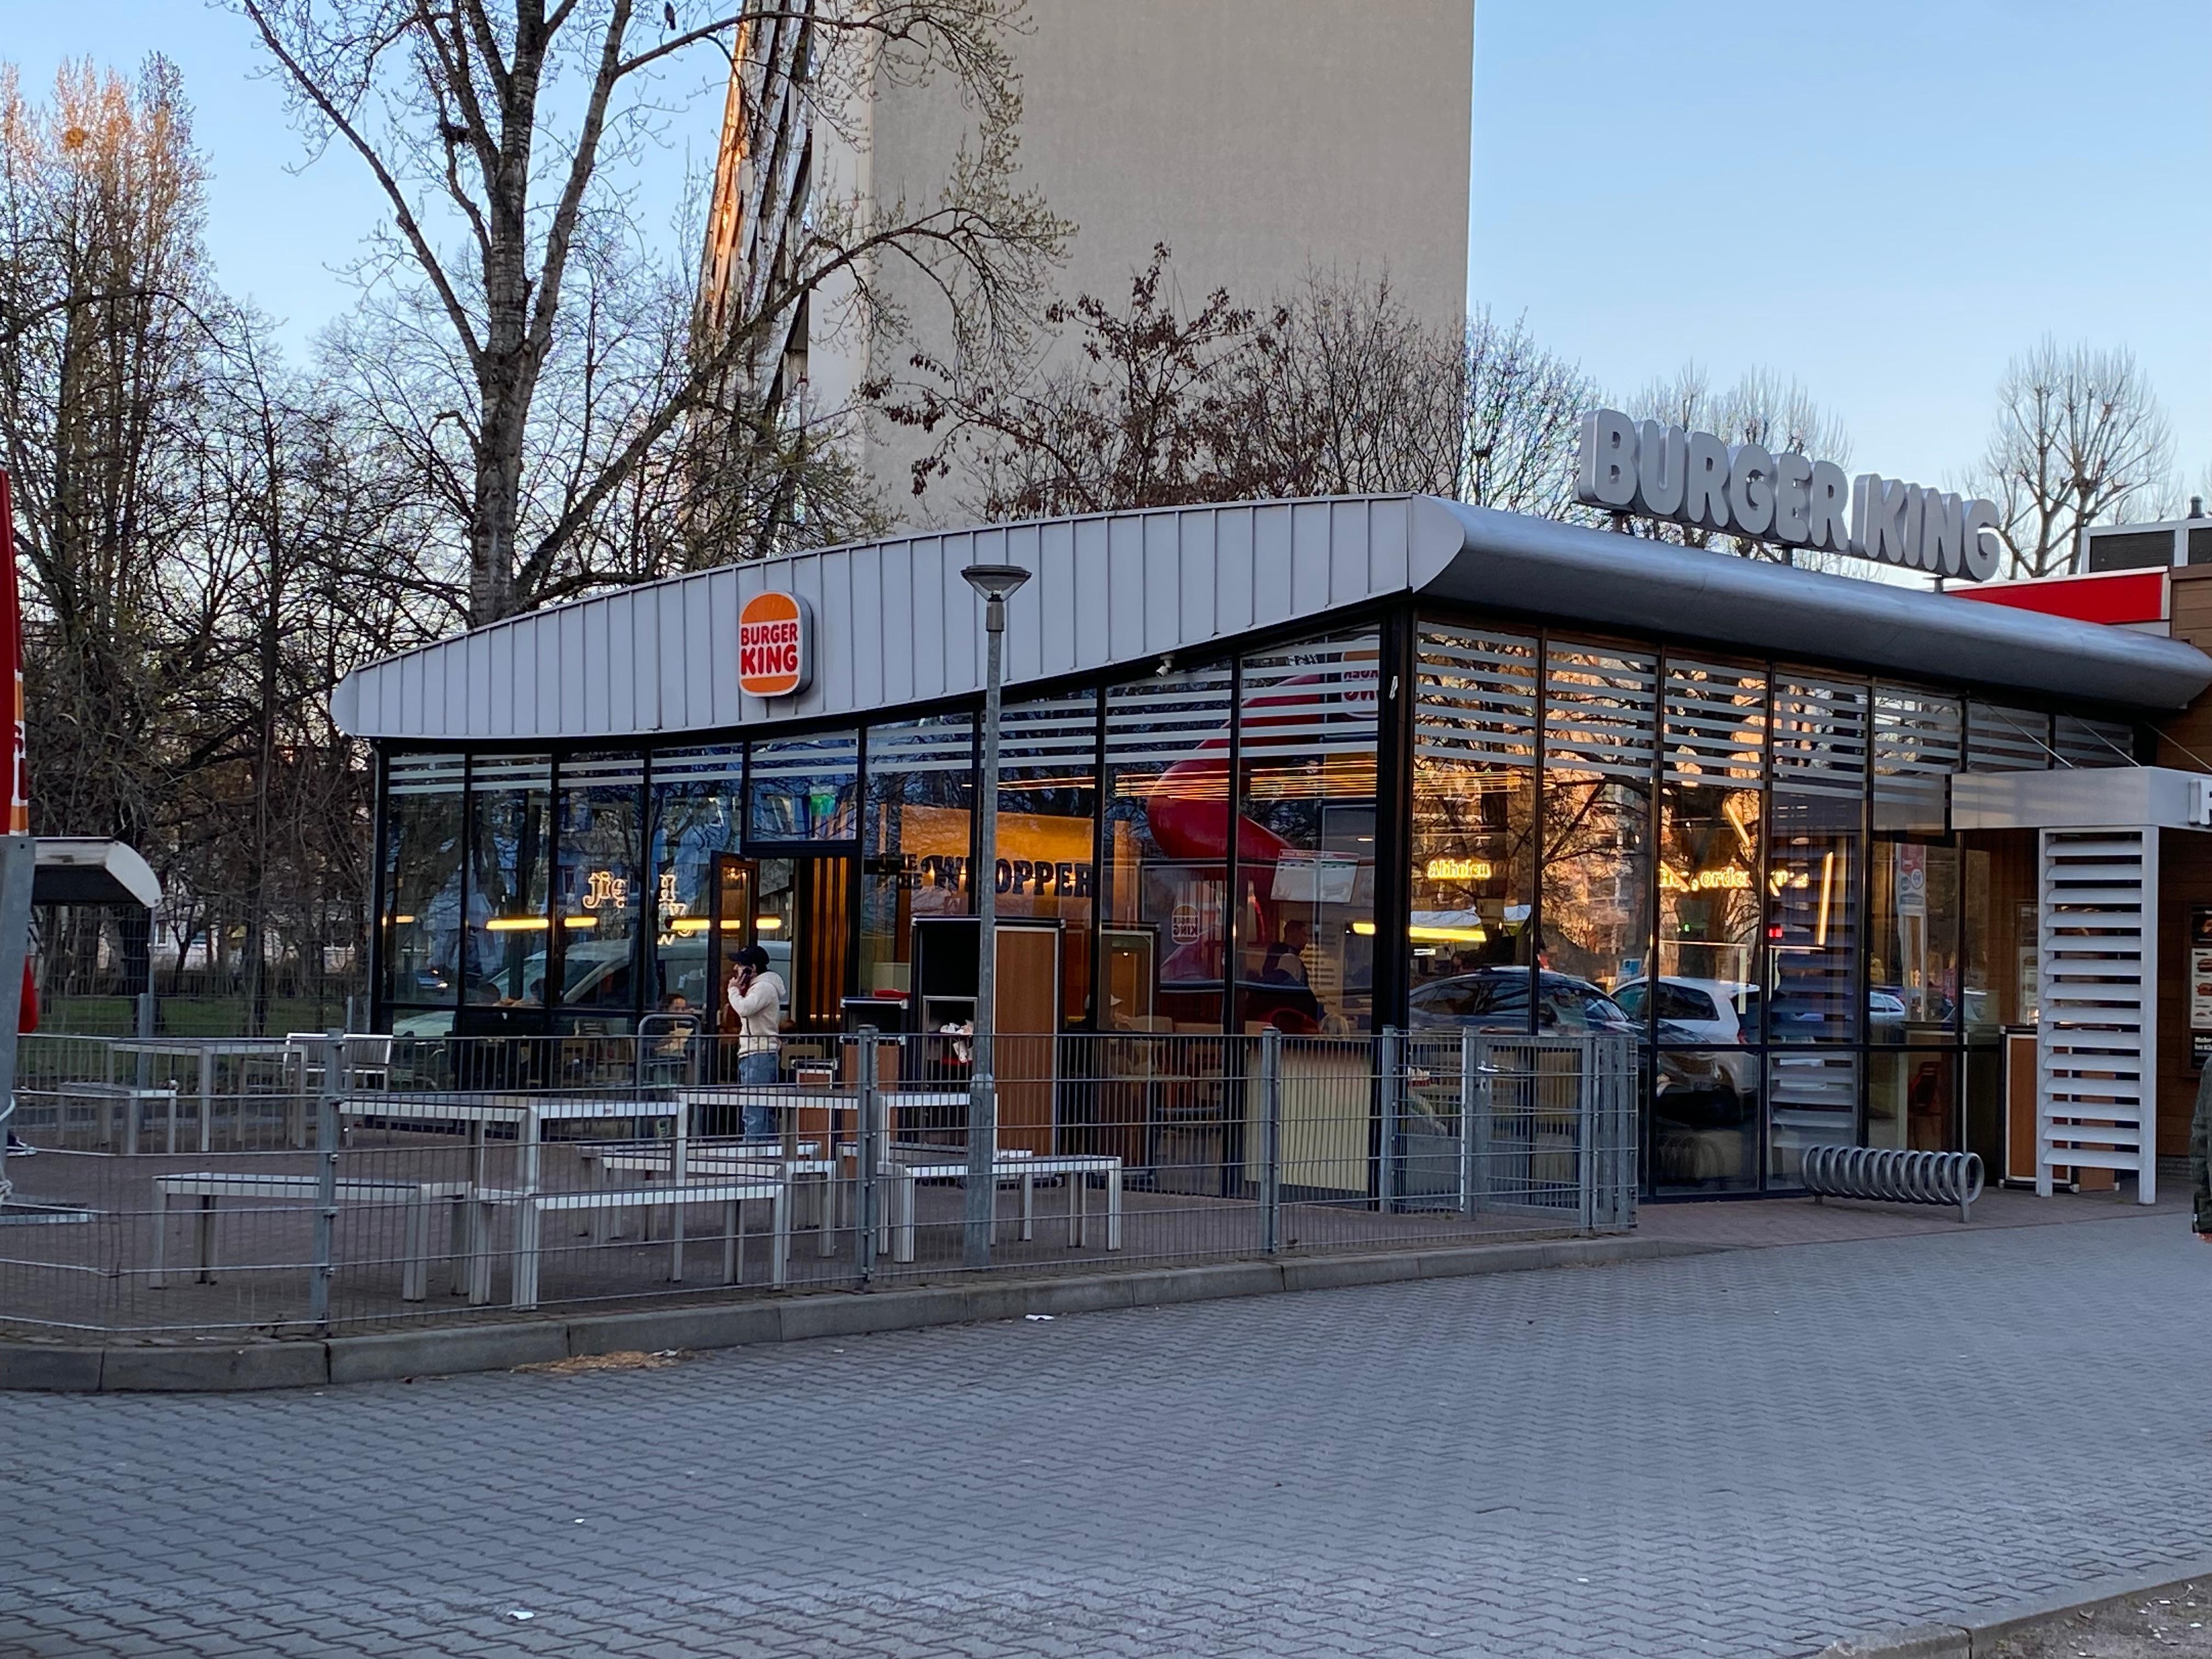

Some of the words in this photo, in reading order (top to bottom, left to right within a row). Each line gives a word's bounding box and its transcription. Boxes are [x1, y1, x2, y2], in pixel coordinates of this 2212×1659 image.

[1579, 409, 1849, 550] BURGER
[1851, 473, 2000, 582] KING
[741, 622, 798, 646] BURGER
[741, 644, 798, 675] KING
